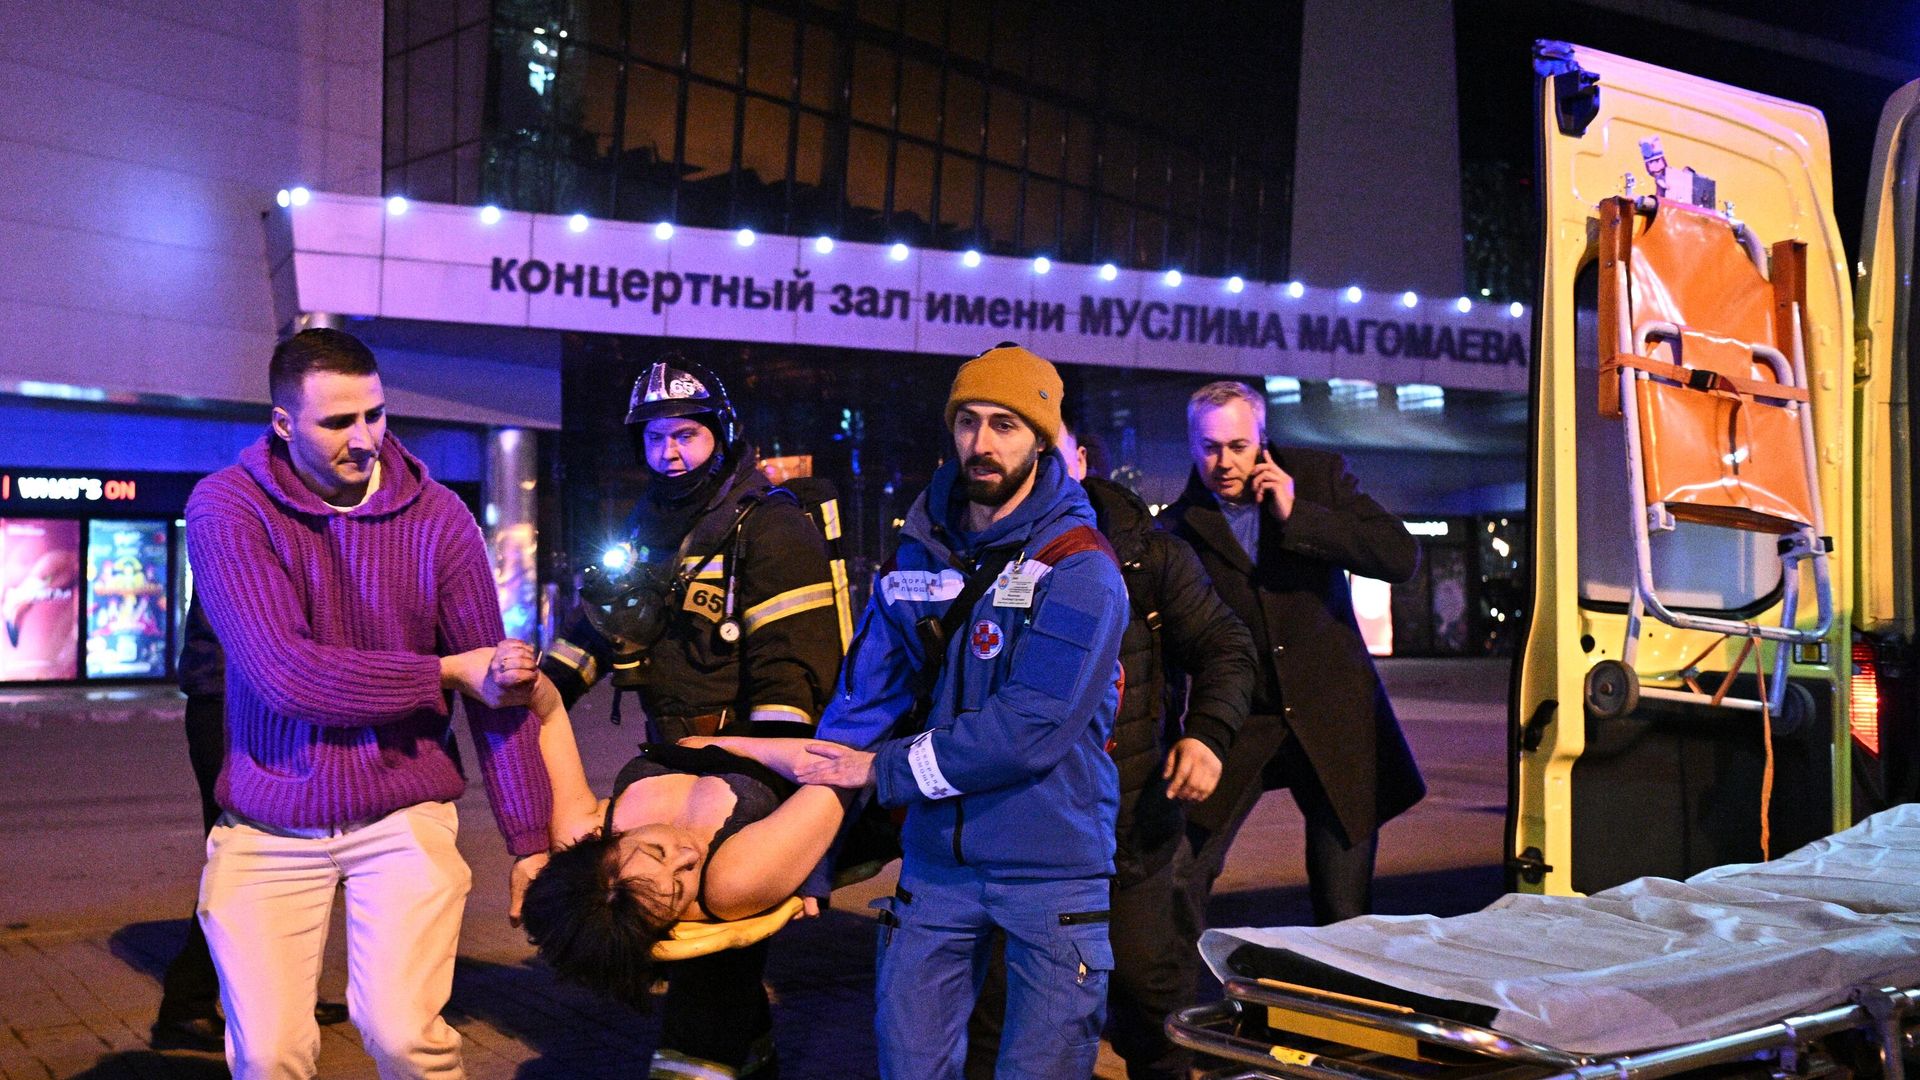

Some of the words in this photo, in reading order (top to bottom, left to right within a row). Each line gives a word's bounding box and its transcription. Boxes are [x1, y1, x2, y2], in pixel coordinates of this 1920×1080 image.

[490, 257, 815, 316] концертный
[829, 283, 910, 320] зал
[925, 291, 1065, 333] имени
[1079, 294, 1289, 350] МУСЛИМА
[1298, 313, 1527, 367] МАГОМАЕВА
[104, 480, 136, 500] ON
[693, 589, 725, 614] 65
